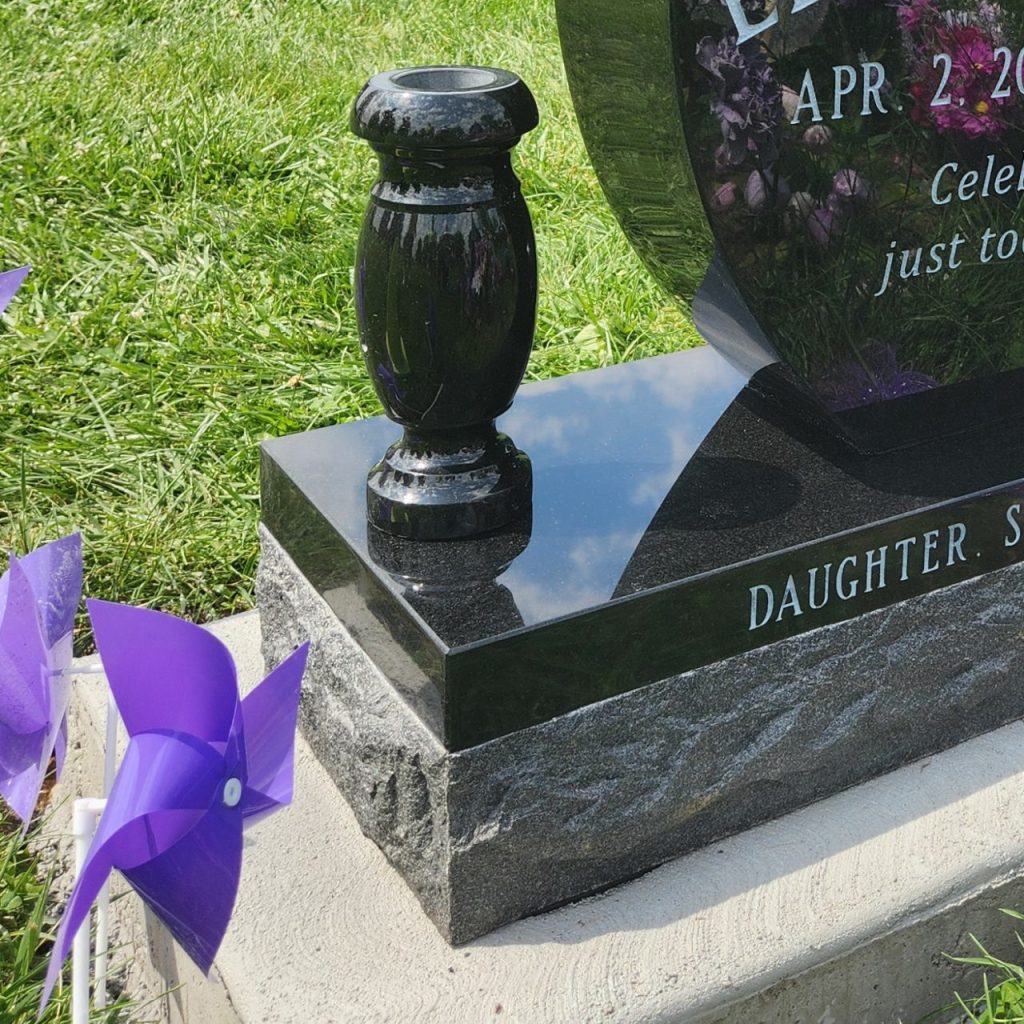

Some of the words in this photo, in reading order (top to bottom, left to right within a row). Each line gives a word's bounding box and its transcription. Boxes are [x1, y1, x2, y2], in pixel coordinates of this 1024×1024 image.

[790, 61, 904, 125] APR.
[930, 52, 967, 108] 2,
[874, 233, 966, 298] just
